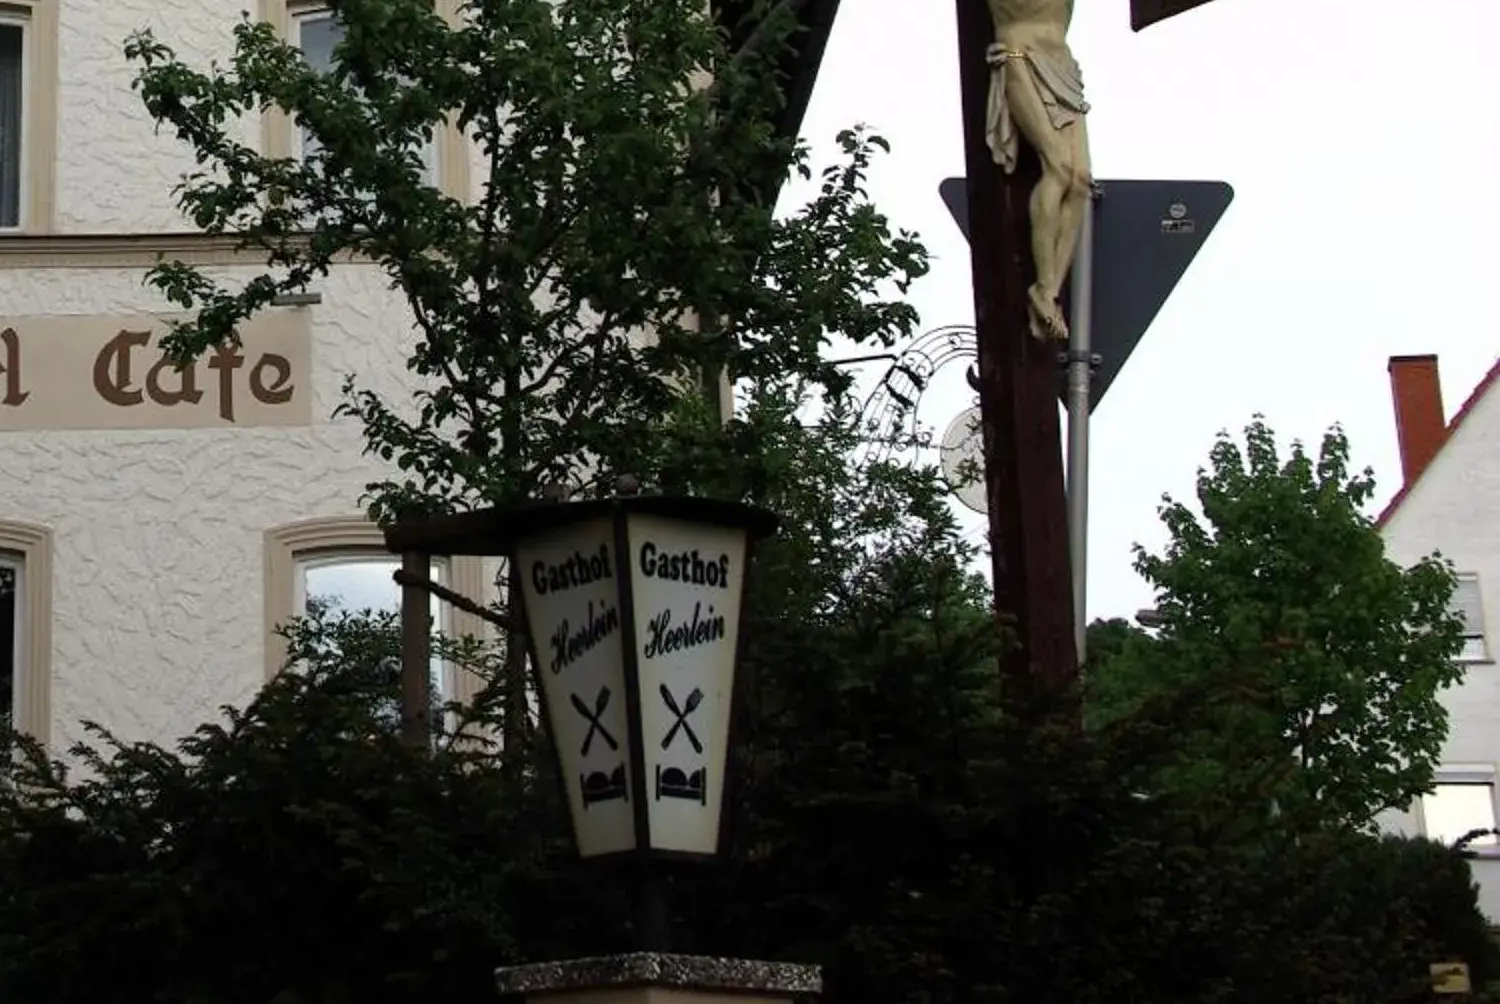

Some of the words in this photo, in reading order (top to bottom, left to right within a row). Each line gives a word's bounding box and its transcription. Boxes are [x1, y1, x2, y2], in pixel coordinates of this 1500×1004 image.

[93, 327, 295, 423] Cafe
[531, 543, 612, 596] Gasthof
[640, 541, 730, 589] Gasthof
[644, 601, 725, 660] Heerlein
